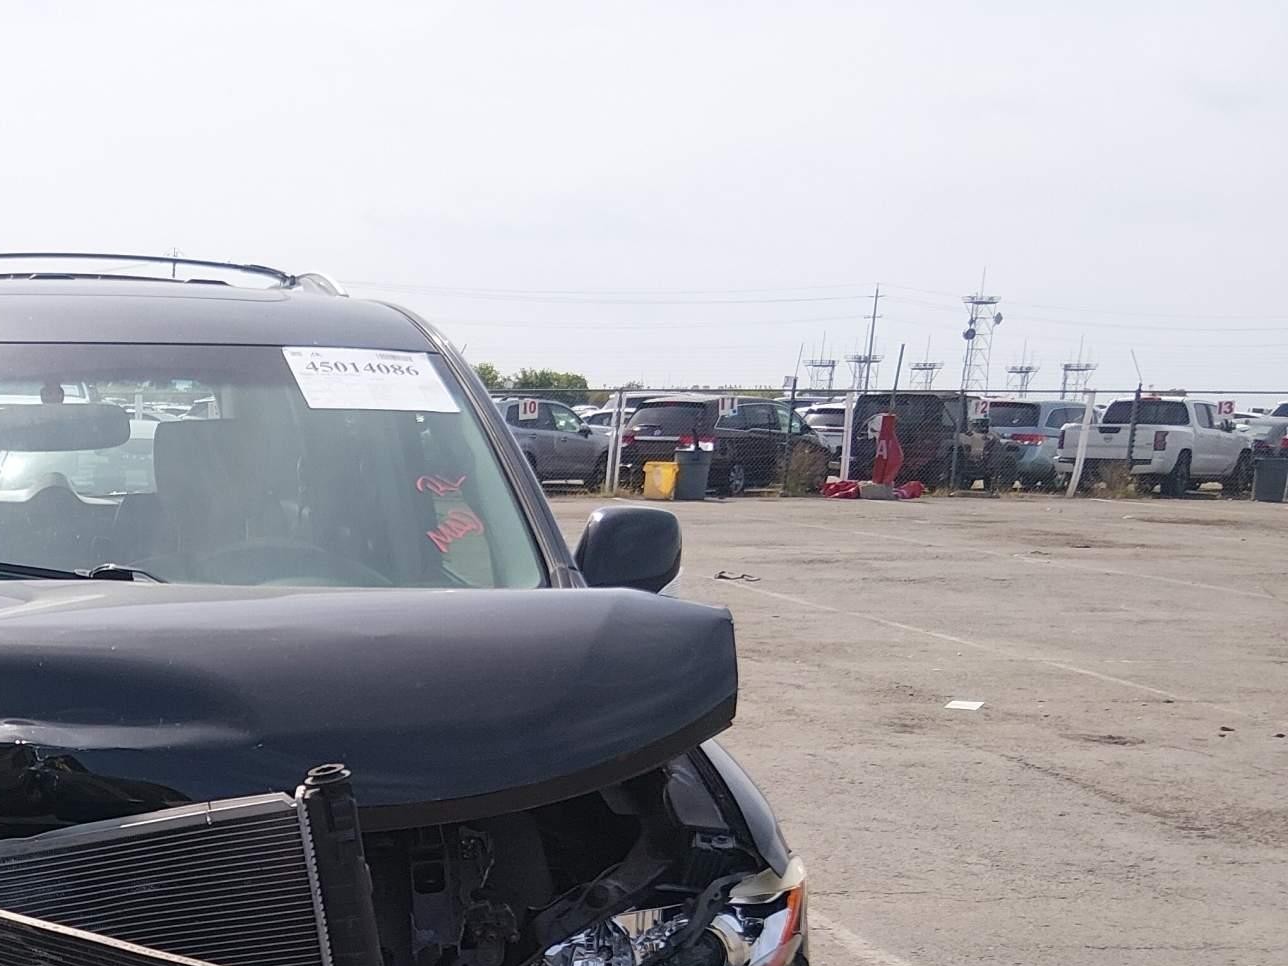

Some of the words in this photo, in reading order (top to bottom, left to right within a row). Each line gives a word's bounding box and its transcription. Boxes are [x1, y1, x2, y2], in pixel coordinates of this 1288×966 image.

[305, 361, 420, 376] 45014086
[523, 401, 537, 415] 10
[1217, 400, 1234, 415] 13
